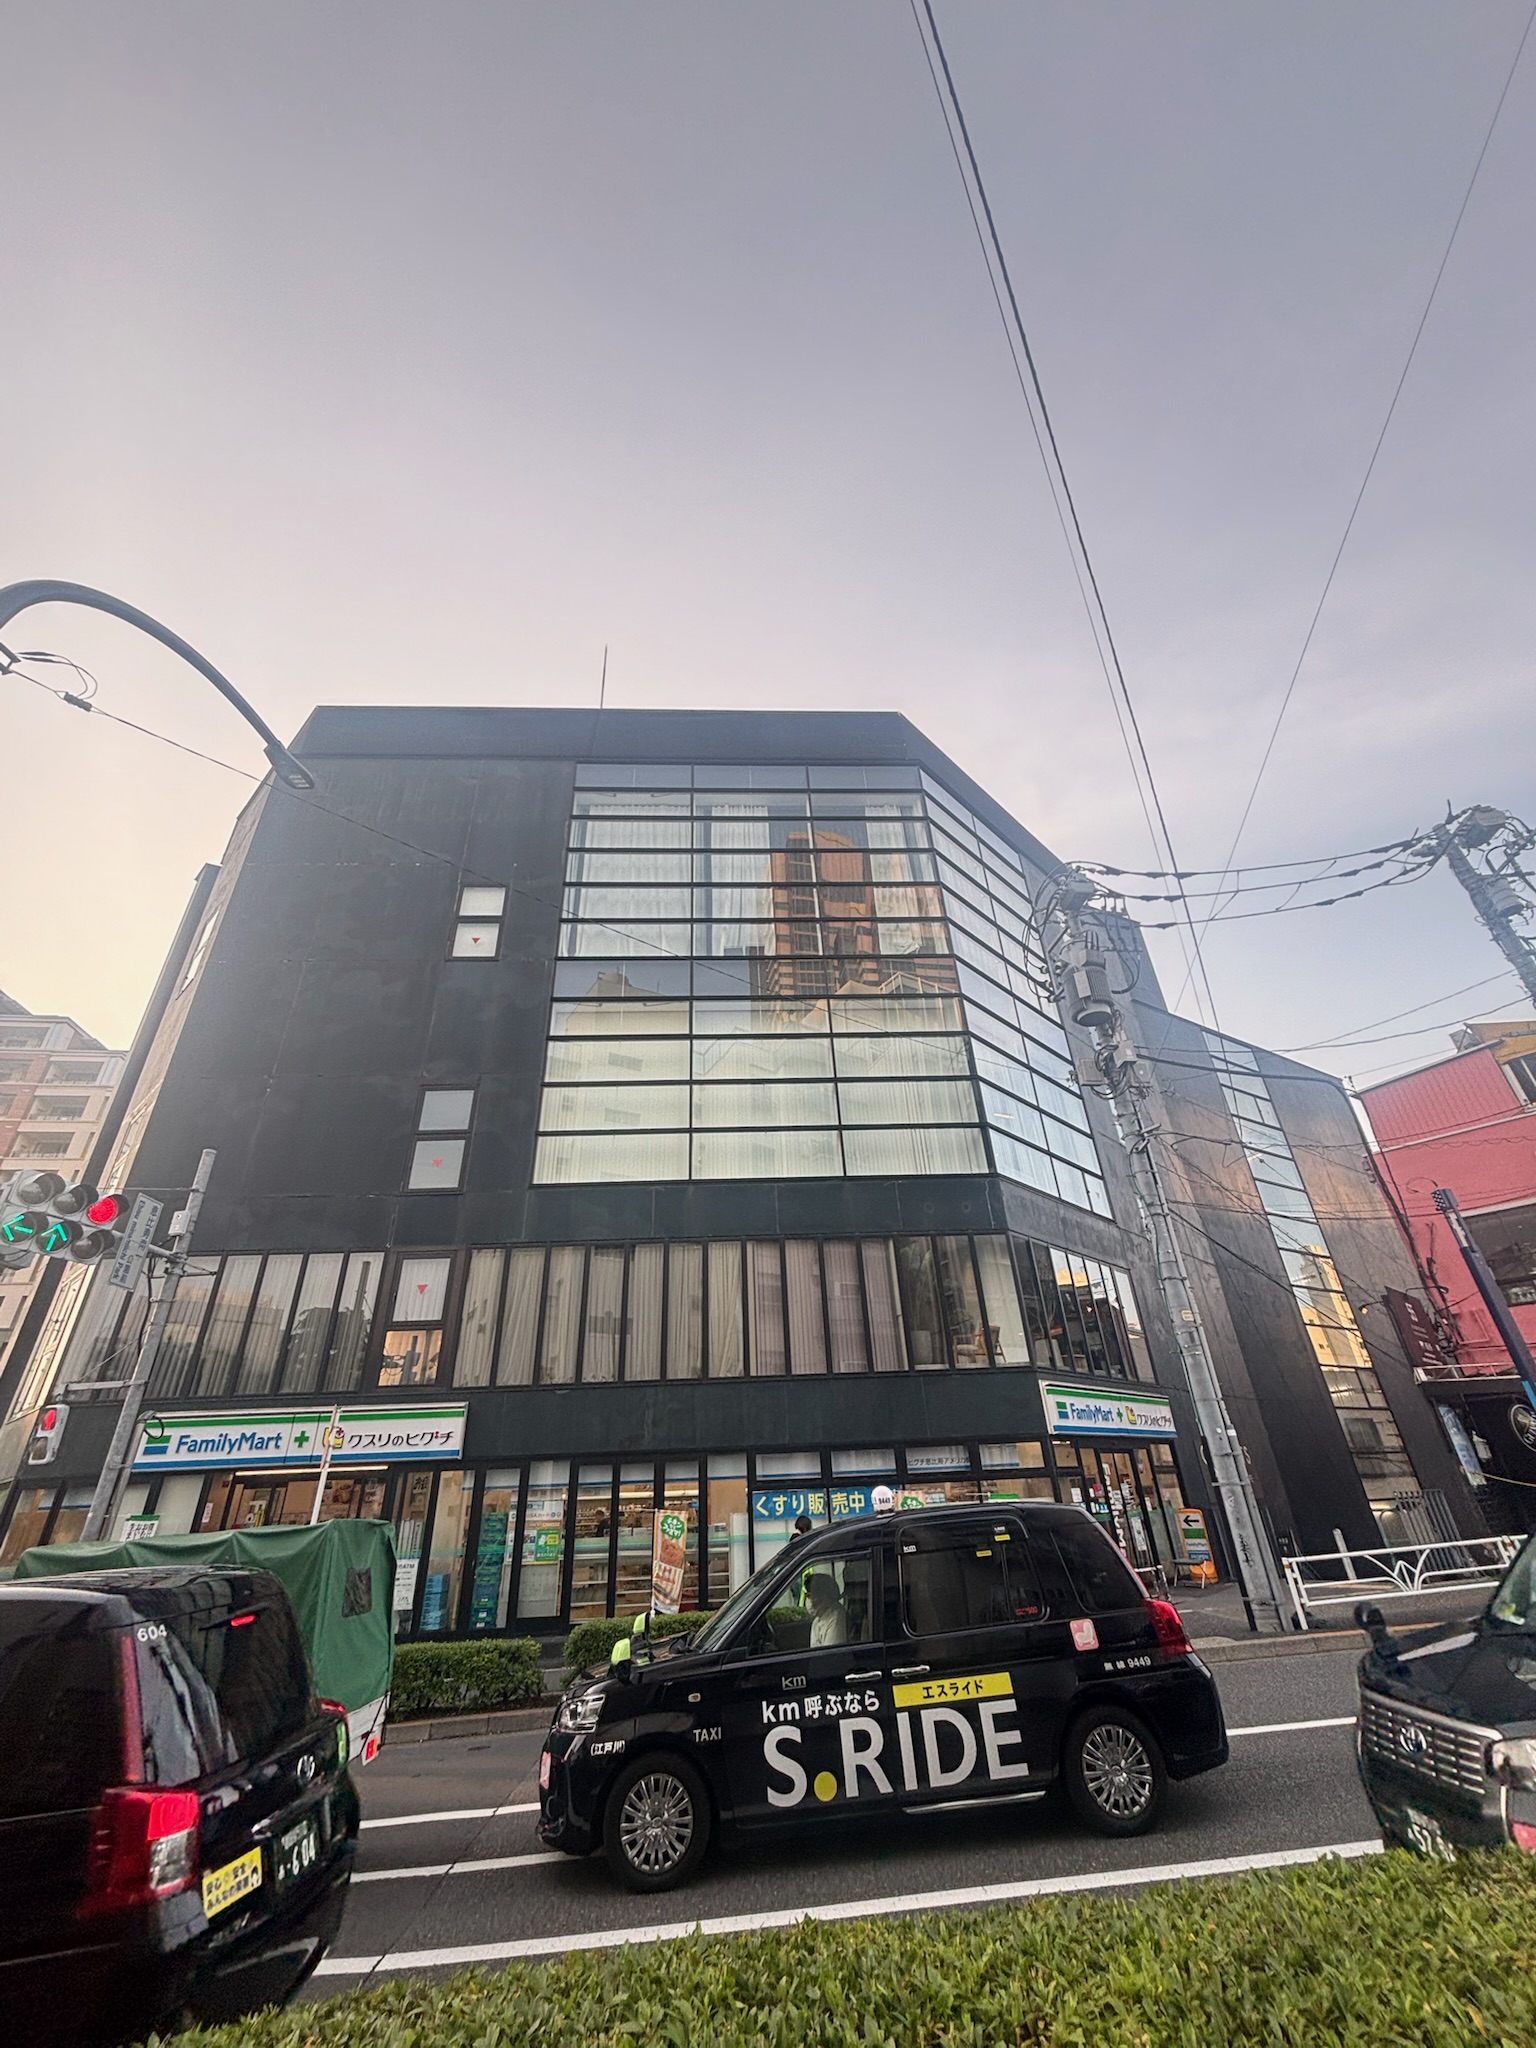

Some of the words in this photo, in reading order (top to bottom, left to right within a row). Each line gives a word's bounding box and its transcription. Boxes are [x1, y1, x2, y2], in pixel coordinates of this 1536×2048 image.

[112, 1261, 124, 1279] Park
[1070, 1402, 1115, 1424] FamilyMart
[175, 1430, 282, 1454] FamilyMart
[347, 1430, 455, 1448] クスリのヒグチ
[755, 1491, 866, 1517] くすり販売中
[137, 1624, 168, 1642] 604
[1127, 1655, 1151, 1669] 9449
[782, 1675, 807, 1690] km
[922, 1679, 984, 1699] エスライド
[693, 1727, 722, 1743] TAXI
[590, 1740, 626, 1756] (江戸川)
